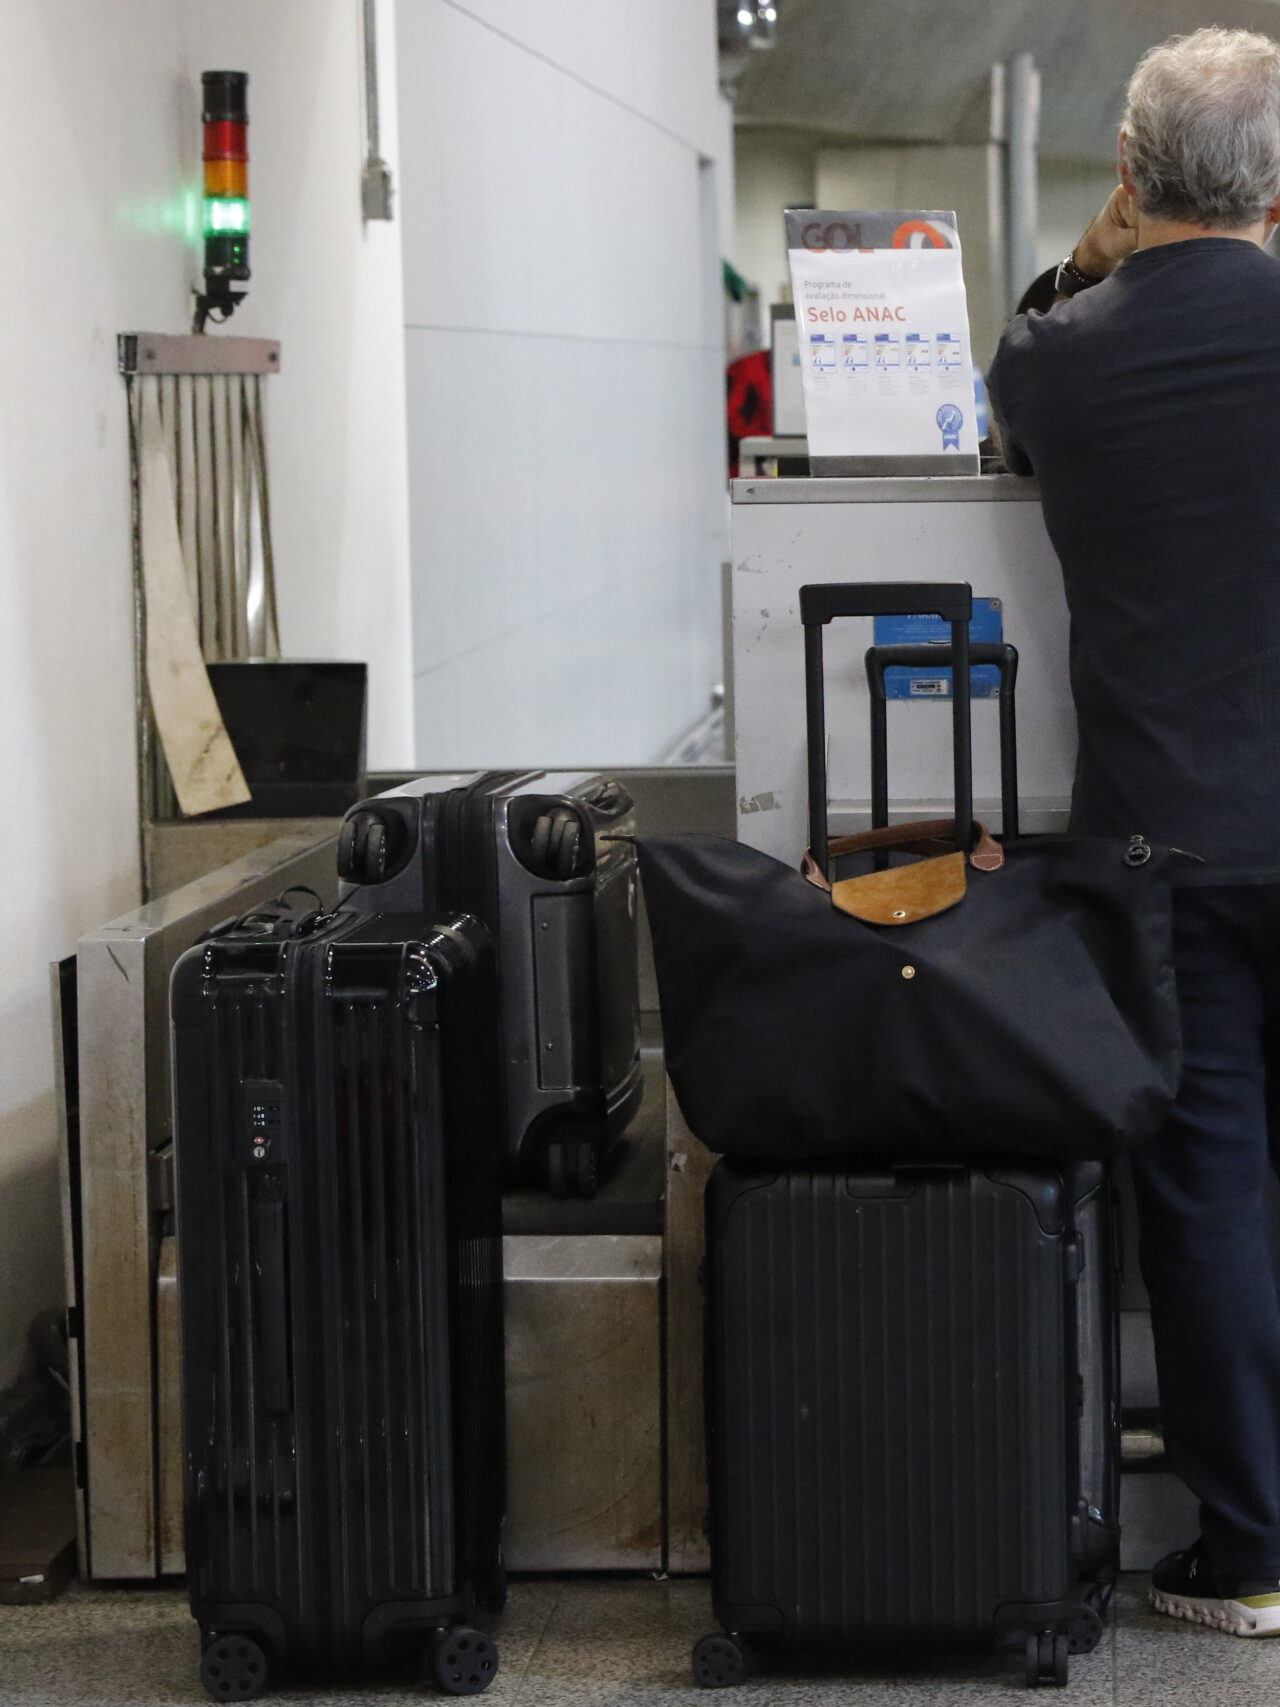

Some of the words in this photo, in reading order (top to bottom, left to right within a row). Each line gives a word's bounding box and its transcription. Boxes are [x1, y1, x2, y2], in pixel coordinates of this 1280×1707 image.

[801, 222, 874, 253] GOL
[804, 280, 841, 291] Programa
[842, 280, 852, 289] de
[805, 291, 840, 302] avaliação
[841, 291, 886, 300] dimensional
[807, 306, 847, 323] Selo
[853, 306, 906, 322] ANAC
